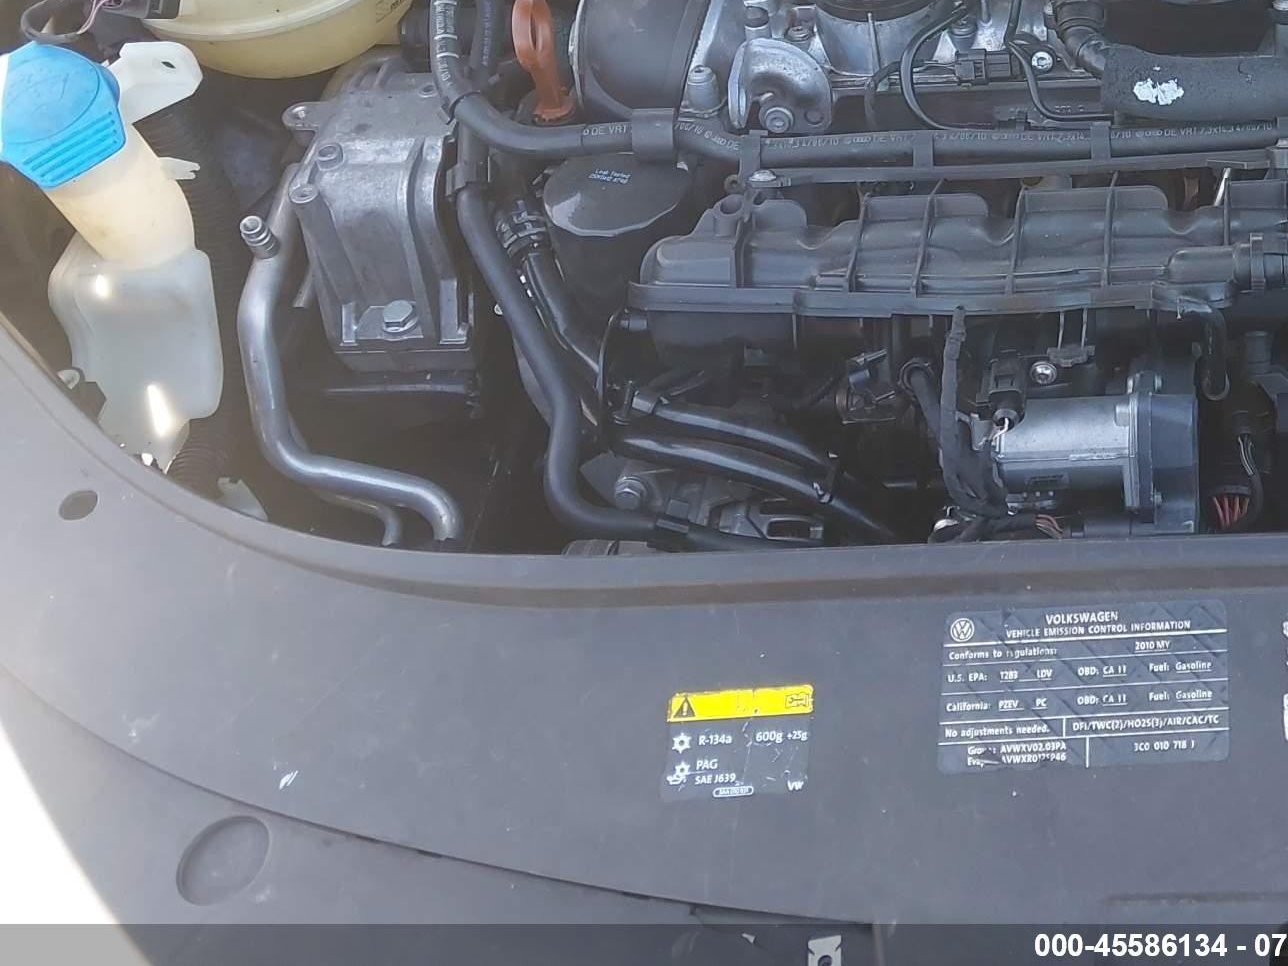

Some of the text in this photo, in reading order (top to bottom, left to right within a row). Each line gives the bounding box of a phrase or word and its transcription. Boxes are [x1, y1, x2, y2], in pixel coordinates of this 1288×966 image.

[1046, 611, 1118, 625] VOLKSWAGEN
[1005, 620, 1191, 638] VEHICLE EMISSION CONTROL INFORMATION
[1135, 641, 1155, 651] 2010
[949, 649, 989, 661] Conforms
[992, 649, 1003, 658] to
[968, 672, 988, 682] EPA:
[1037, 669, 1053, 679] LDV
[1077, 666, 1099, 676] OBD:
[1103, 665, 1114, 675] CA
[1149, 662, 1170, 672] Fuel:
[1175, 660, 1212, 672] Gasoline
[998, 699, 1018, 709] PZEV
[1036, 698, 1047, 708] PC
[1077, 695, 1099, 705] OBD:
[1103, 694, 1114, 704] CA
[1149, 691, 1170, 701] Fuel:
[1175, 689, 1213, 700] Gasoline
[945, 724, 1050, 739] No adjustments needed.
[698, 734, 733, 746] R-134a
[755, 731, 783, 744] 600g
[1134, 741, 1150, 752] 3C0
[1153, 740, 1169, 751] 010
[696, 758, 718, 771] PAG
[695, 772, 736, 785] SAE J639
[787, 780, 804, 791] VW
